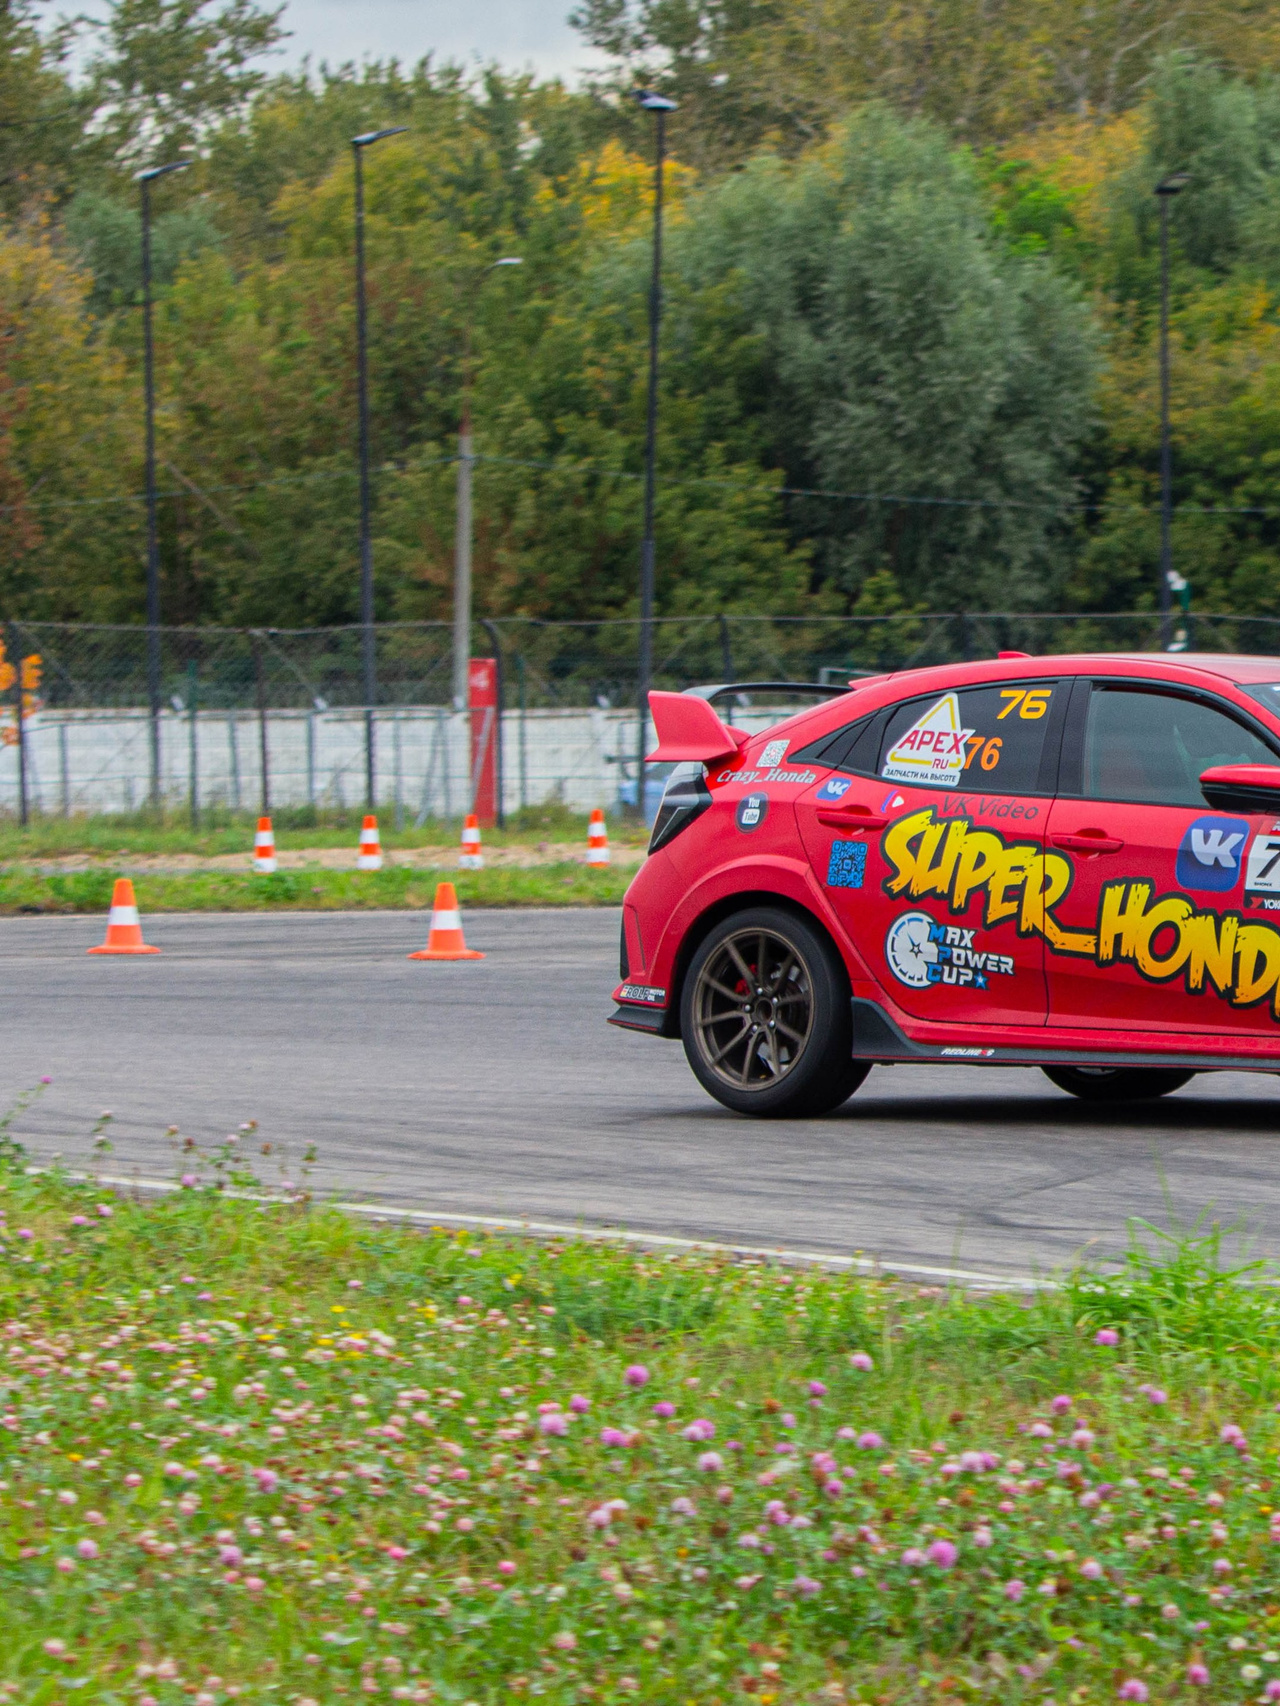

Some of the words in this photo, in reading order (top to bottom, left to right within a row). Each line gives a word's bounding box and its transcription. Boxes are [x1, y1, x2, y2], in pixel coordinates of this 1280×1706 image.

[996, 689, 1052, 720] 76
[896, 729, 969, 755] APEX
[931, 758, 950, 770] RU
[963, 736, 1003, 771] 76
[716, 768, 817, 785] Crazy_Honda
[885, 768, 919, 779] ЗАПЧАСТИ
[919, 771, 930, 780] НА
[929, 773, 957, 783] ВЫСОТЕ
[827, 781, 849, 796] VK
[748, 797, 760, 809] You
[942, 795, 973, 815] VK
[977, 797, 1040, 820] Video
[745, 811, 758, 822] Tube
[1190, 828, 1245, 868] VK
[928, 922, 977, 949] MAX
[937, 945, 1015, 976] POWER
[926, 964, 974, 986] CUP
[626, 985, 650, 1001] ROLF
